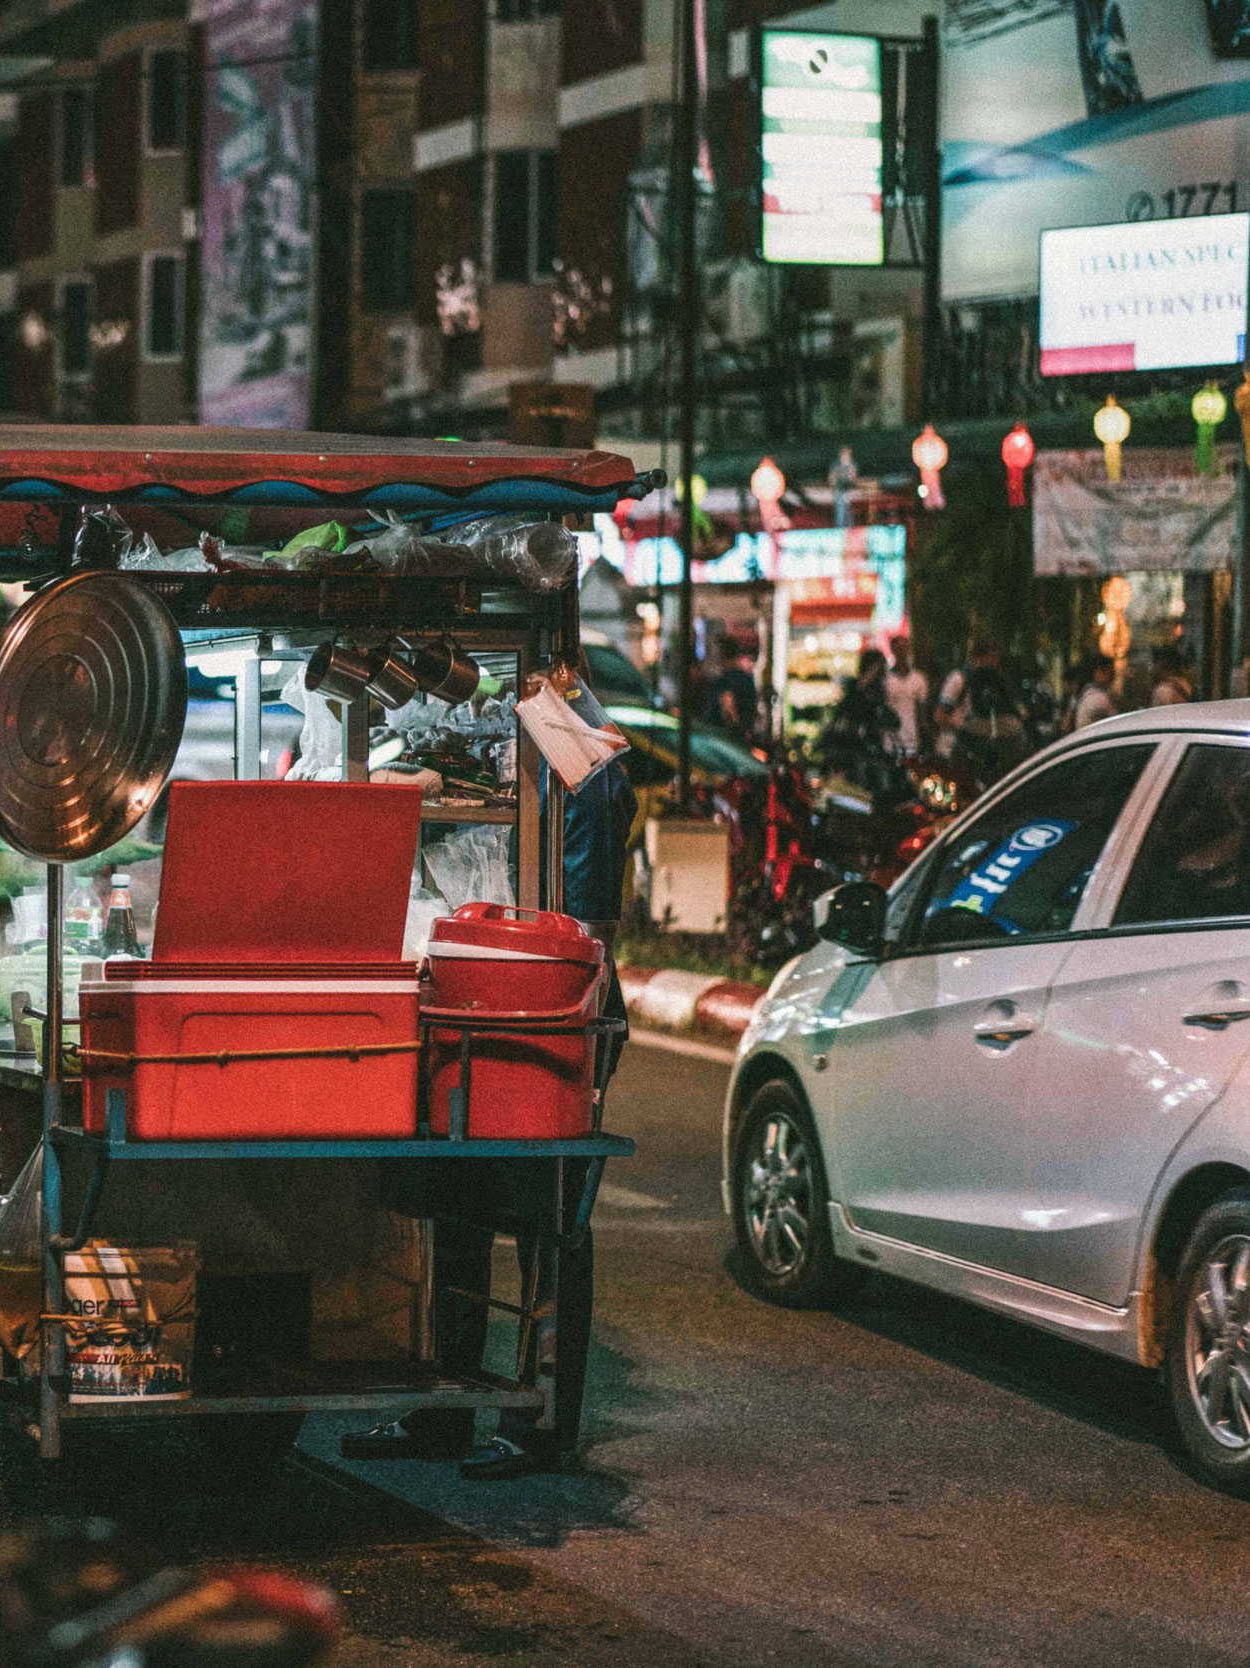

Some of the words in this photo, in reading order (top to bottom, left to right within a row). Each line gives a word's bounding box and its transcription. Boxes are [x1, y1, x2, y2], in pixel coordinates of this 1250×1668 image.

[1161, 180, 1238, 218] 1771
[1079, 248, 1177, 275] ITALIAN
[1078, 294, 1195, 320] WESTERN
